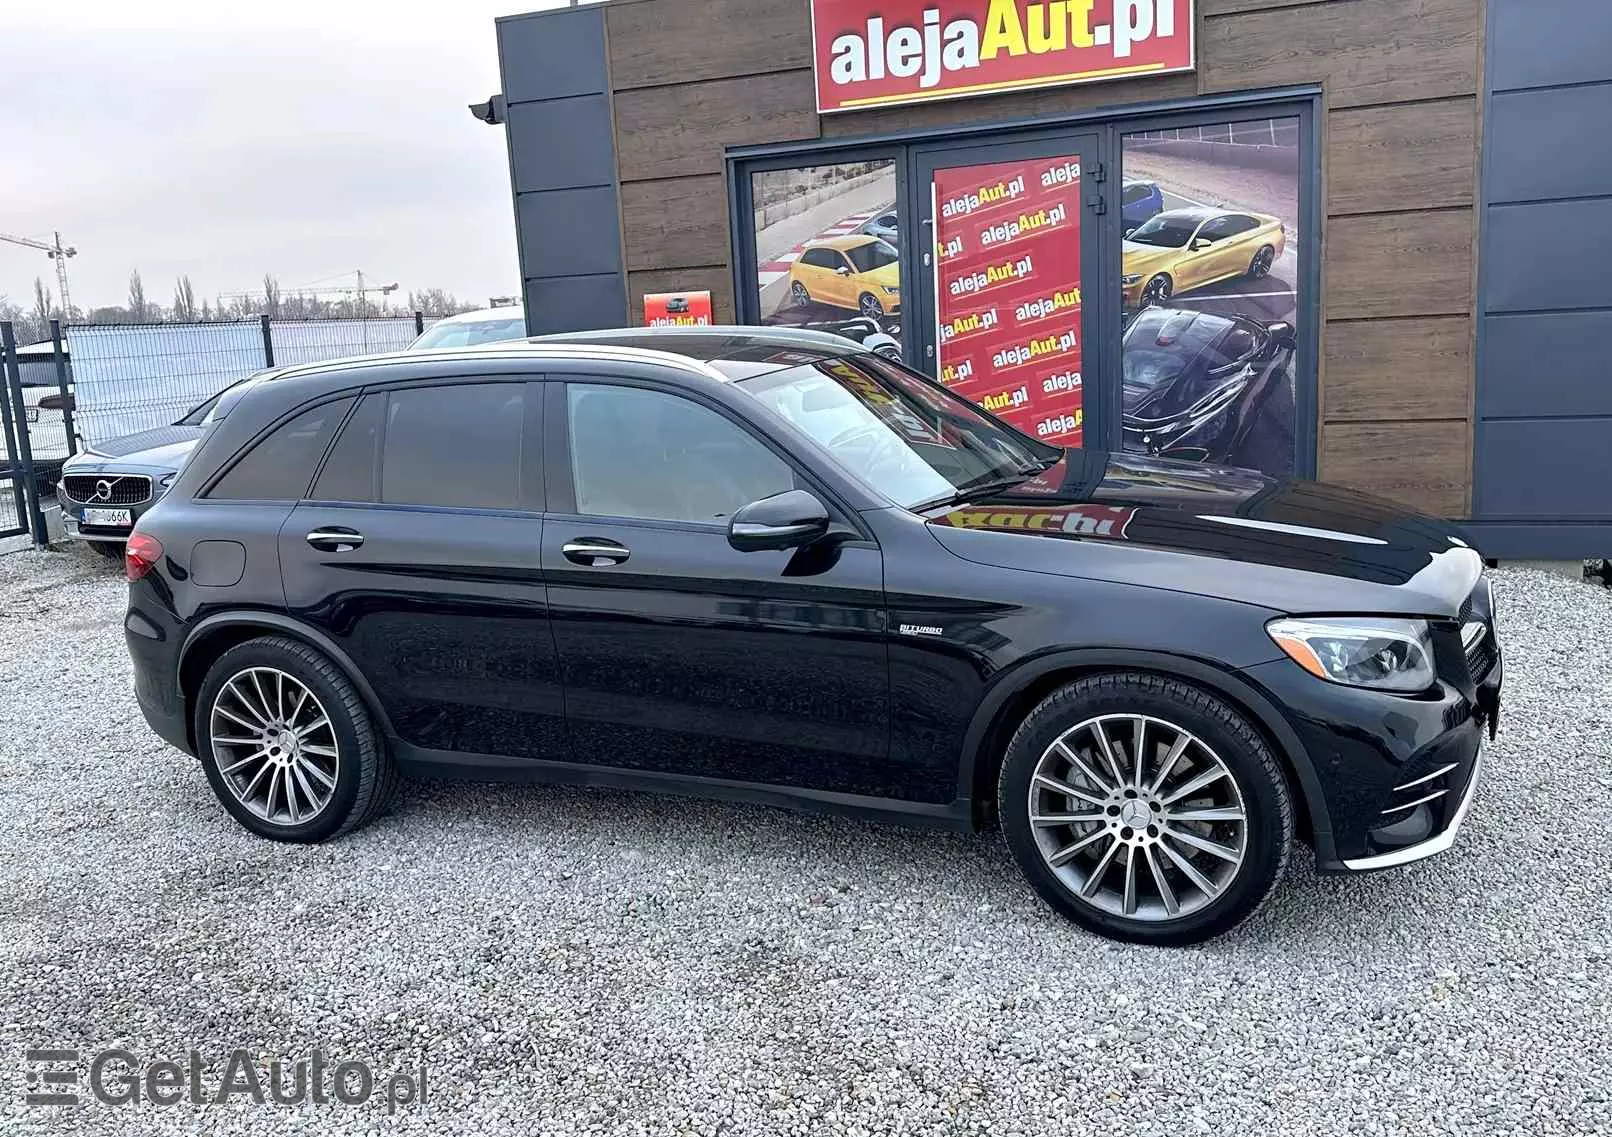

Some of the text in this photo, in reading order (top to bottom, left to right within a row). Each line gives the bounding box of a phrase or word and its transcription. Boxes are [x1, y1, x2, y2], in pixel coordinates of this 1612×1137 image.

[830, 0, 1175, 88] alejaAut.pl
[1041, 163, 1081, 187] aleja
[941, 176, 1025, 217] alejaAut.pl
[981, 204, 1066, 245] alejaAut.pl
[950, 256, 1033, 295] alejaAut.pl
[1015, 287, 1081, 321] alejaAut
[992, 331, 1077, 368] alejaAut.pl
[1043, 372, 1082, 393] aleja
